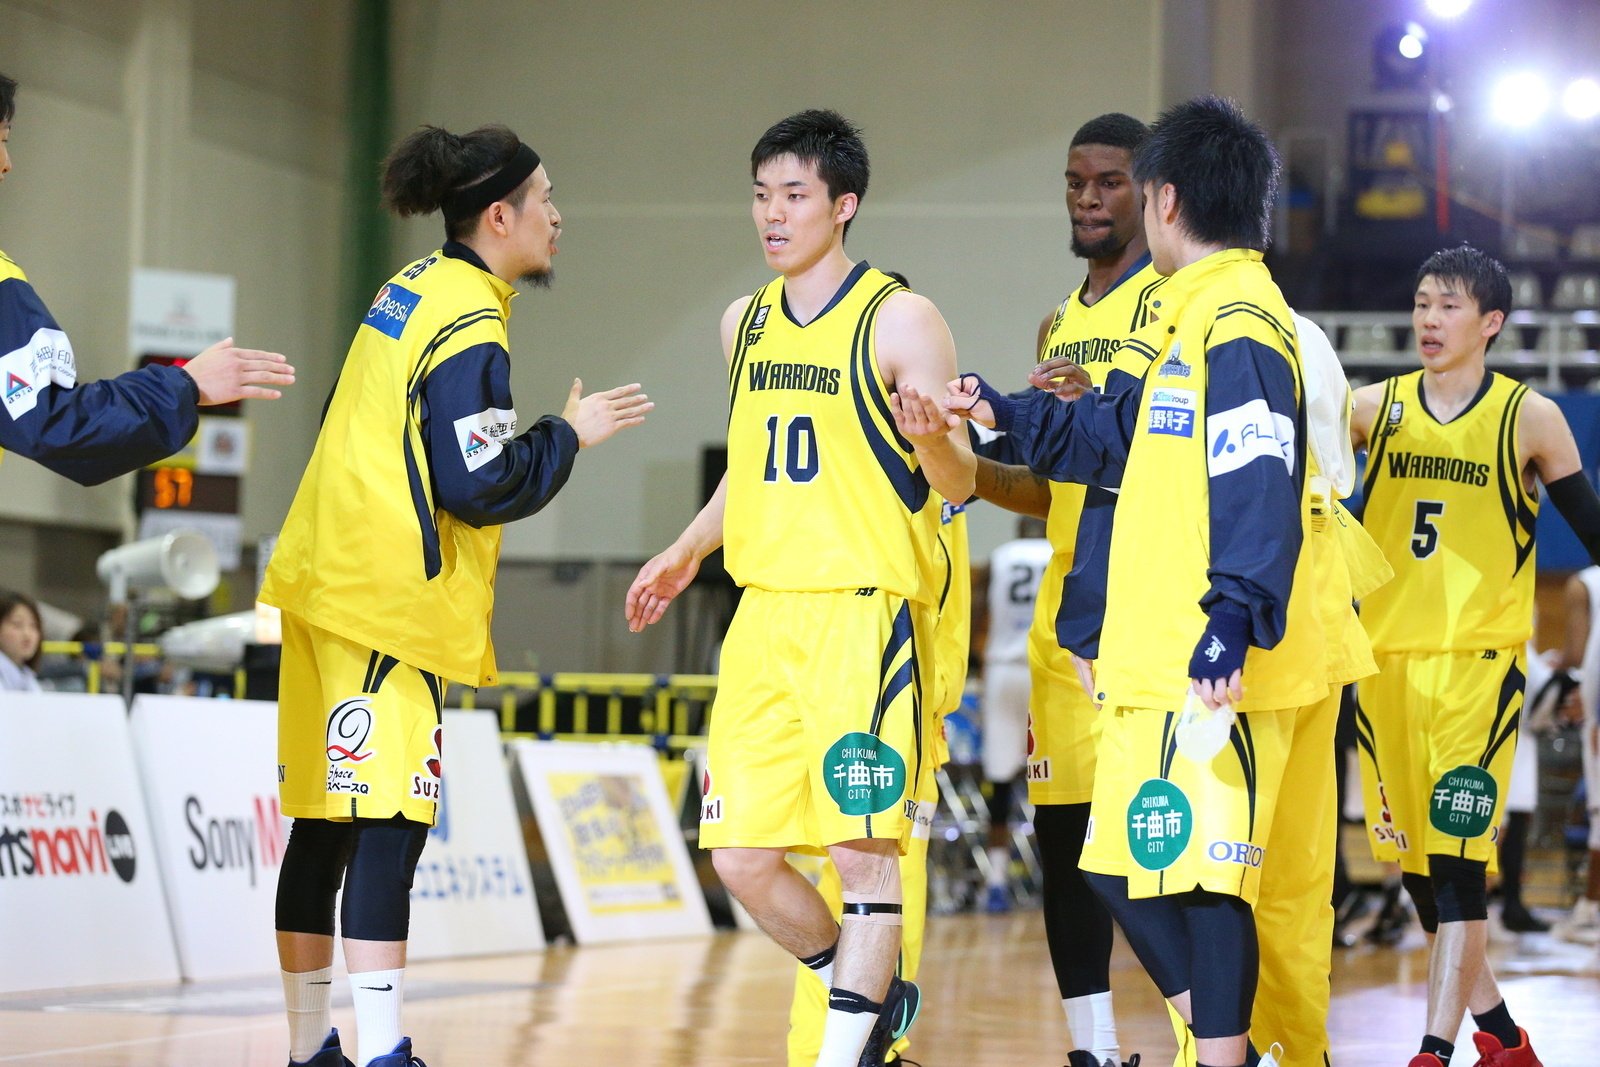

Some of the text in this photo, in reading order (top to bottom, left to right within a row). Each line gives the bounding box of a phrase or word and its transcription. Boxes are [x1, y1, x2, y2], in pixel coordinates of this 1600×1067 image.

[376, 296, 411, 321] pepsi
[748, 360, 841, 396] WARRIORS
[762, 414, 820, 483] 10
[1387, 451, 1490, 488] WARRIORS
[1410, 500, 1444, 559] 5
[1008, 563, 1048, 605] 2
[841, 747, 878, 761] CHIKUMA
[832, 760, 896, 790] 千曲市
[1448, 776, 1485, 791] CHIKUMA
[847, 788, 873, 800] CITY
[1141, 795, 1170, 809] CHIKUMA
[1434, 788, 1494, 818] 千曲市
[1131, 808, 1183, 840] 千曲市
[1449, 812, 1472, 825] CITY
[1147, 840, 1165, 853] CITY
[1208, 841, 1265, 868] ORIO
